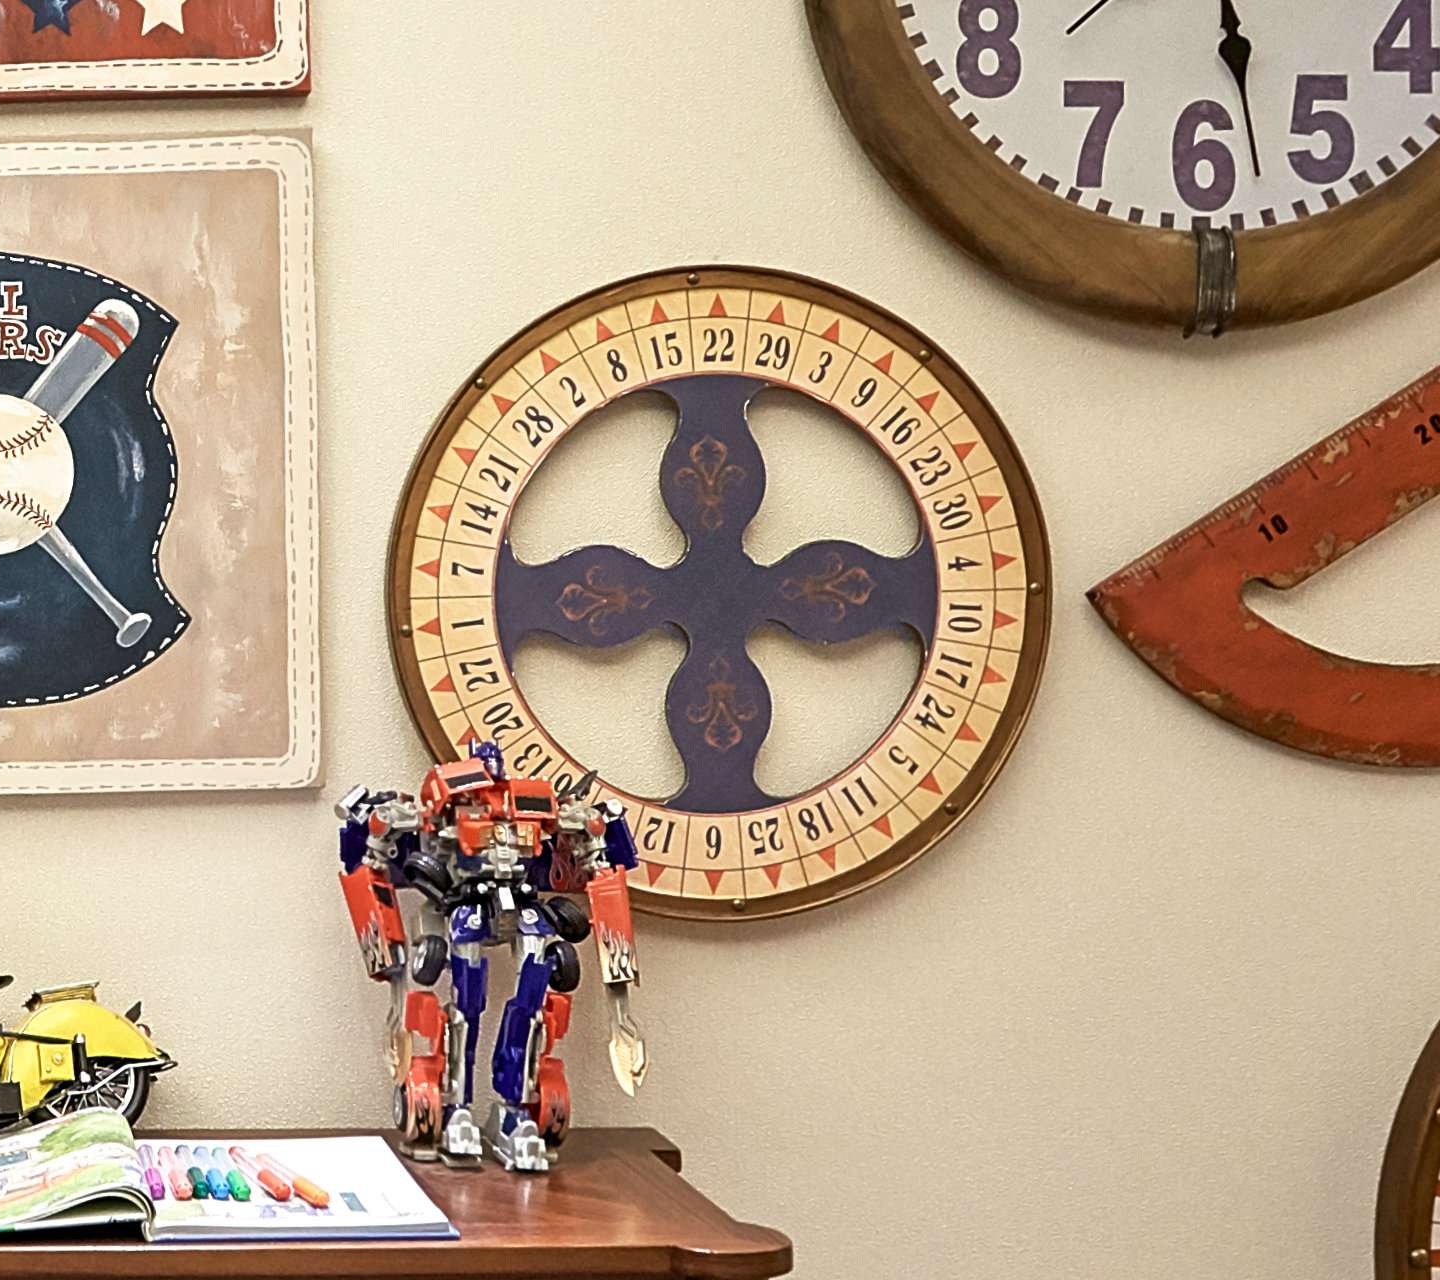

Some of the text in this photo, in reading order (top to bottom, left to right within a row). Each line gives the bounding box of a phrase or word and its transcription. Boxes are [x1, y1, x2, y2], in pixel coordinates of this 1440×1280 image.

[1064, 81, 1124, 188] 7
[1287, 75, 1354, 184] 5
[1172, 100, 1235, 212] 6
[650, 332, 682, 369] 15
[704, 328, 734, 362] 22
[755, 333, 790, 369] 29
[607, 349, 627, 382] 8
[809, 352, 832, 383] 3
[560, 377, 586, 407] 2
[851, 378, 877, 407] 9
[512, 406, 553, 447] 28
[880, 406, 920, 444] 16
[479, 455, 519, 492] 21
[910, 446, 951, 486] 23
[461, 502, 498, 534] 14
[933, 494, 972, 530] 30
[1259, 515, 1288, 542] 10
[452, 562, 484, 576] 7
[948, 557, 982, 571] 4
[451, 619, 484, 629] 1
[948, 604, 982, 632] 10
[459, 658, 499, 692] 27
[936, 653, 972, 688] 17
[483, 703, 523, 745] 20
[914, 694, 955, 733] 24
[514, 744, 552, 779] 13
[889, 746, 918, 775] 5
[842, 777, 877, 816] 11
[644, 817, 675, 853] 12
[748, 818, 784, 855] 25
[798, 802, 834, 841] 18
[706, 826, 721, 859] 6
